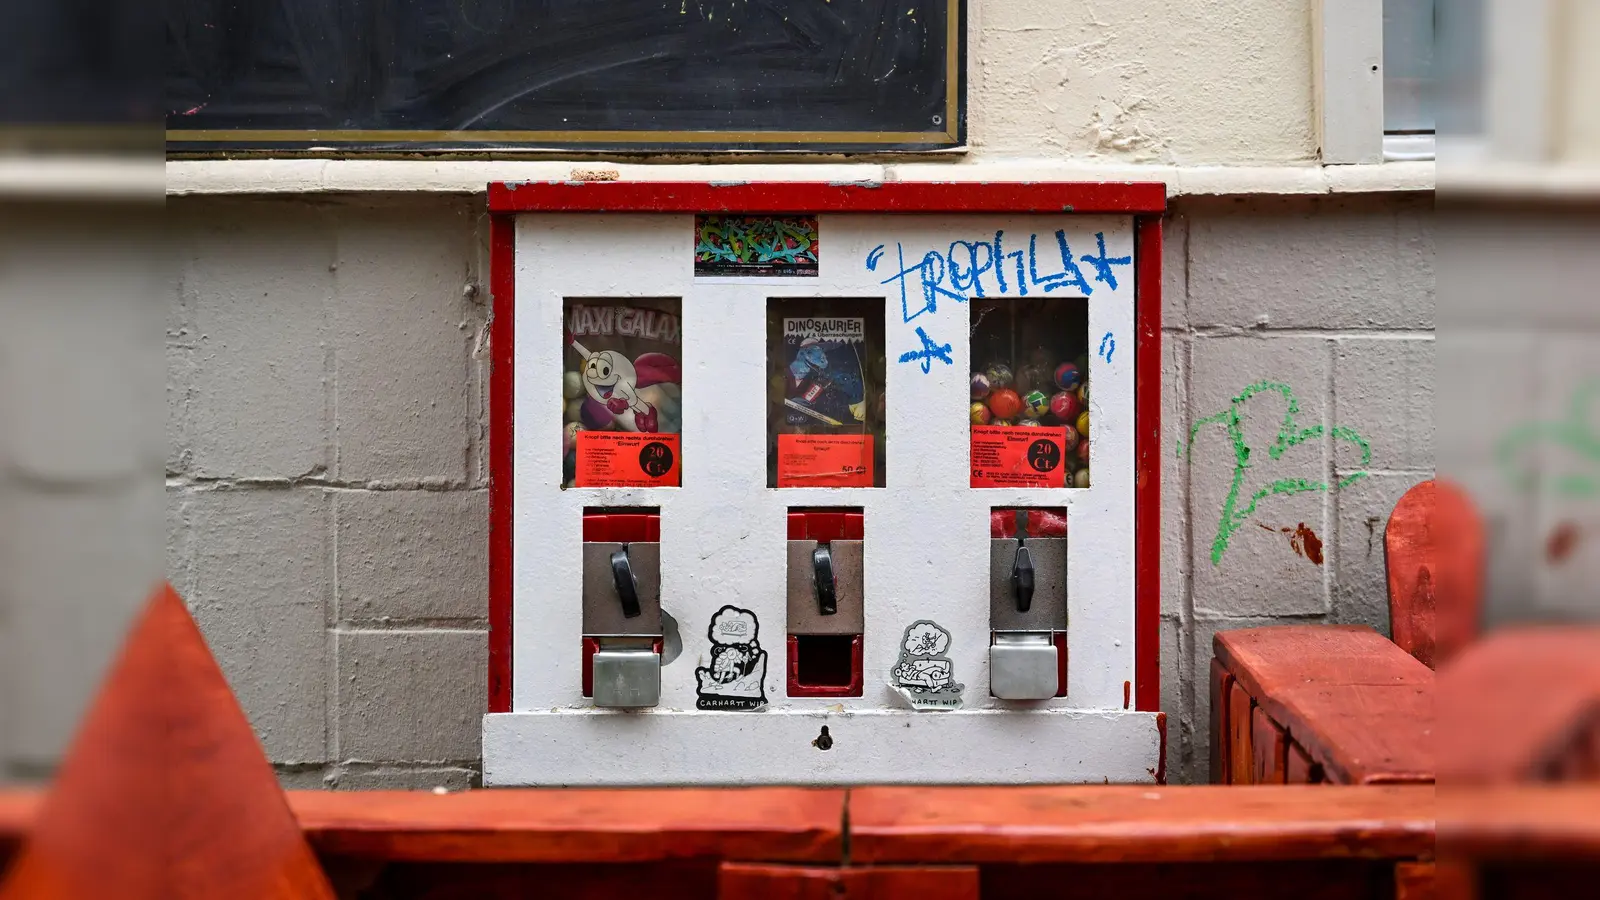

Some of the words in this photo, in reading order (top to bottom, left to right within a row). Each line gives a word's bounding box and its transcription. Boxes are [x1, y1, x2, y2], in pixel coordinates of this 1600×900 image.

[788, 319, 861, 333] DINOSAURIER
[648, 446, 665, 457] 20
[1037, 444, 1051, 454] 20
[911, 698, 938, 706] HARTT
